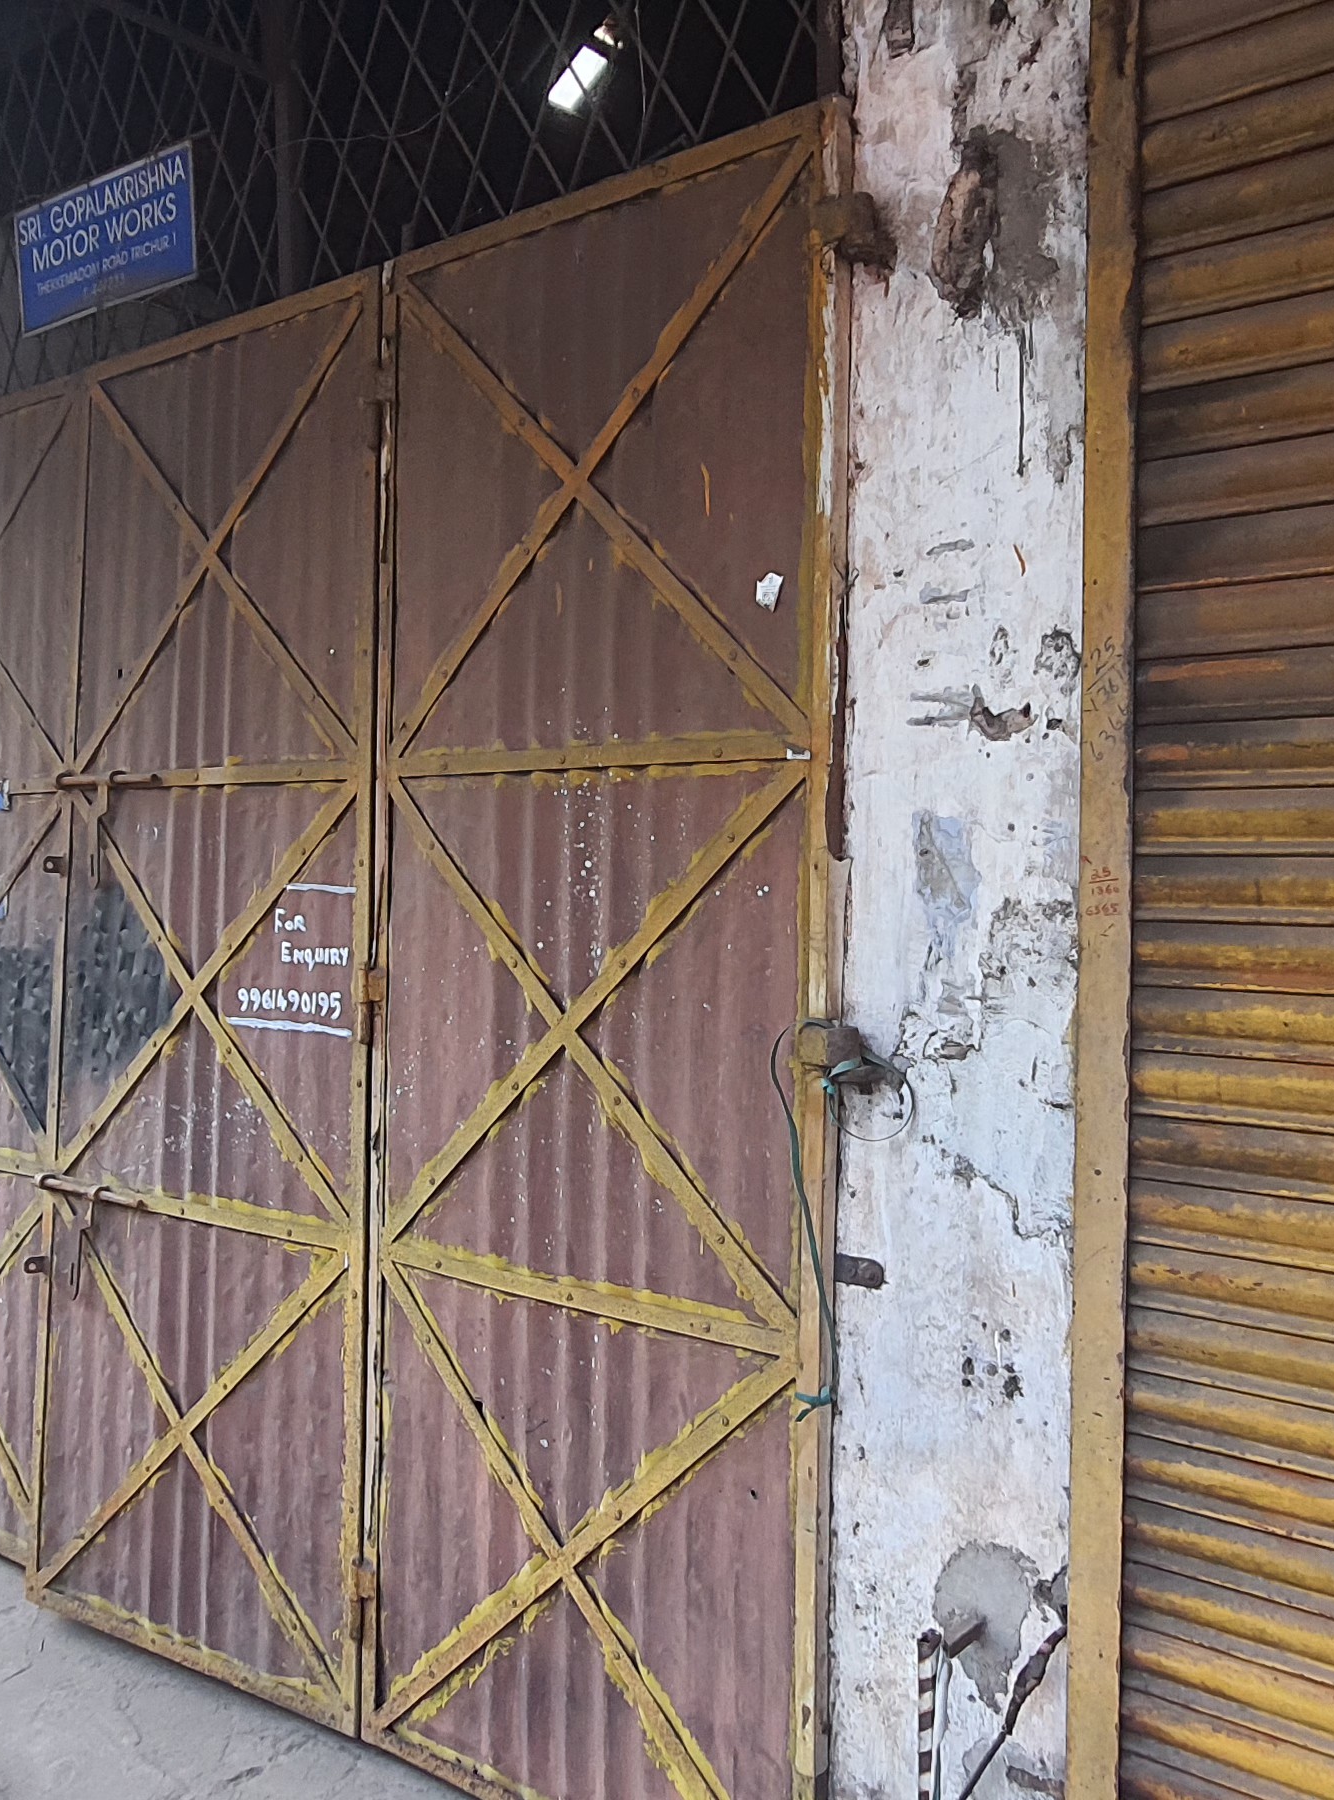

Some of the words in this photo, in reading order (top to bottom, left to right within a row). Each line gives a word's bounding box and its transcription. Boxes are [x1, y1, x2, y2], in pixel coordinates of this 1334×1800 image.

[50, 155, 185, 233] GOPALAKRISHNA
[32, 224, 100, 273] MOTOR
[105, 192, 177, 244] WORKS
[102, 250, 128, 273] ROAD
[131, 236, 170, 262] TRICHUR
[237, 987, 342, 1020] 9961490195
